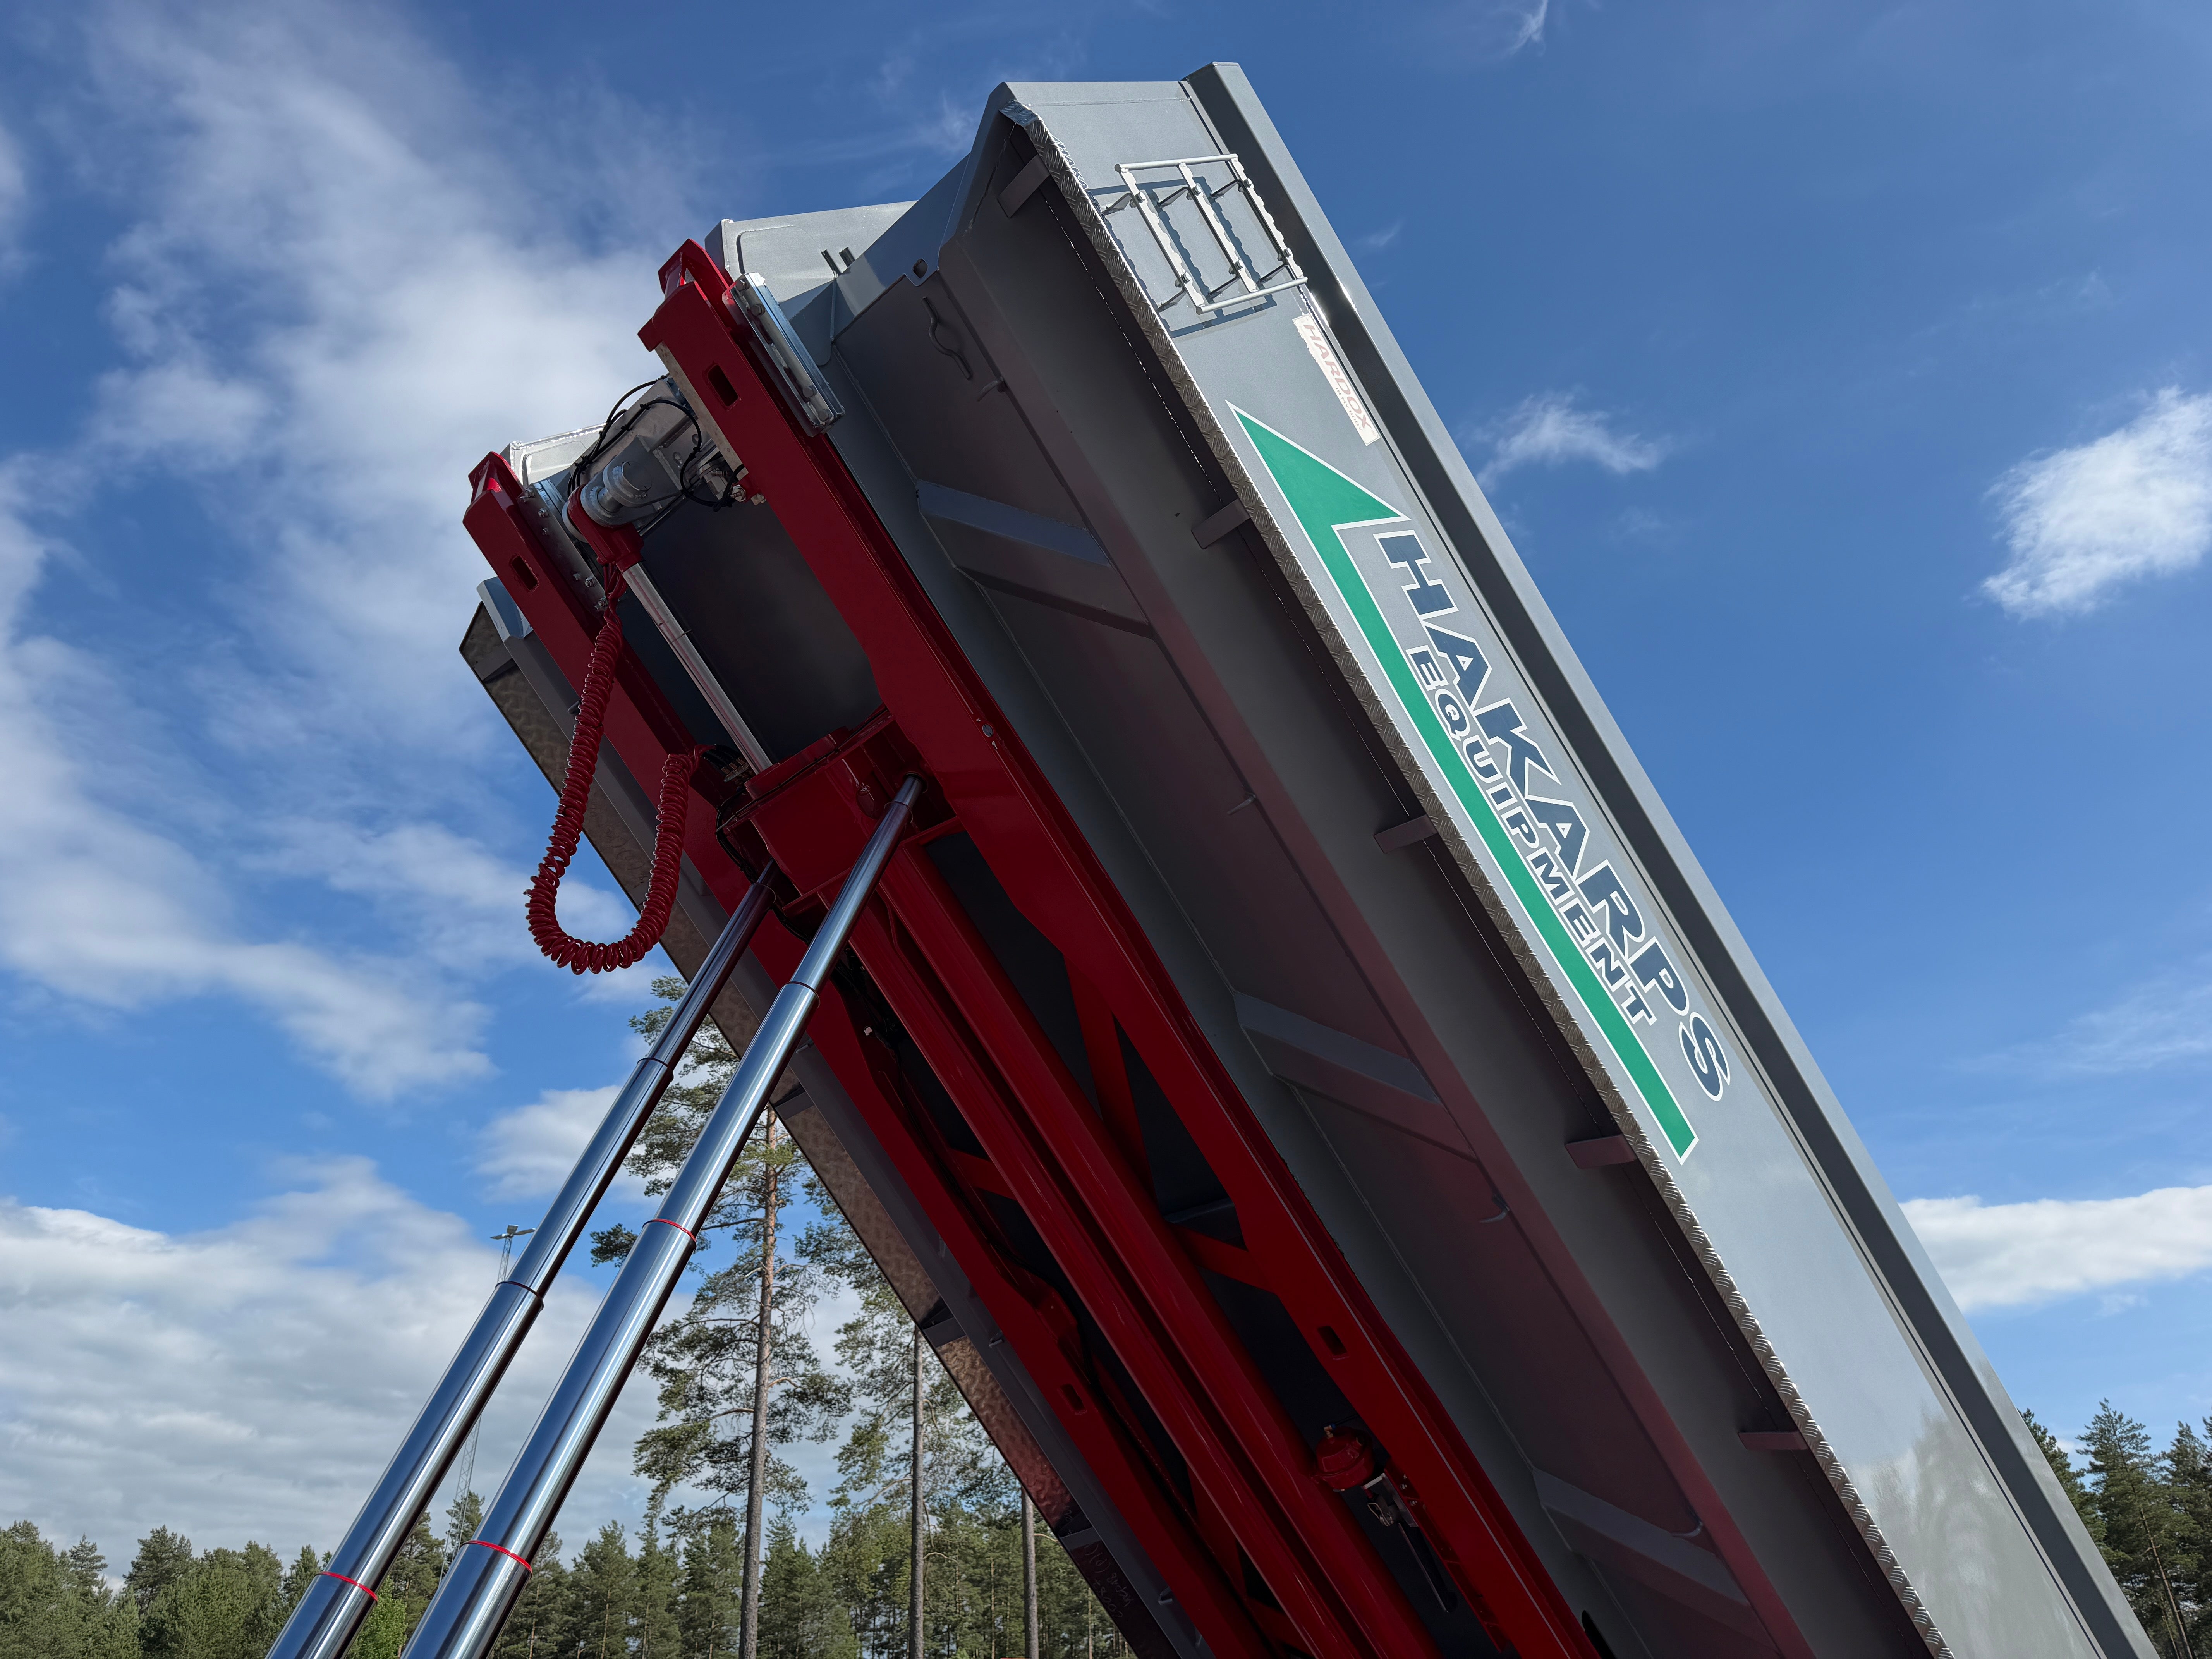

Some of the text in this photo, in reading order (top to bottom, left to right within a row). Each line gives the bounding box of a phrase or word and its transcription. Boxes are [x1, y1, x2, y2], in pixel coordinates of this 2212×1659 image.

[1335, 387, 1363, 431] IN MY BODY
[1374, 530, 1730, 1101] HAKARPS
[1405, 644, 1657, 1028] EQUIPMENT
